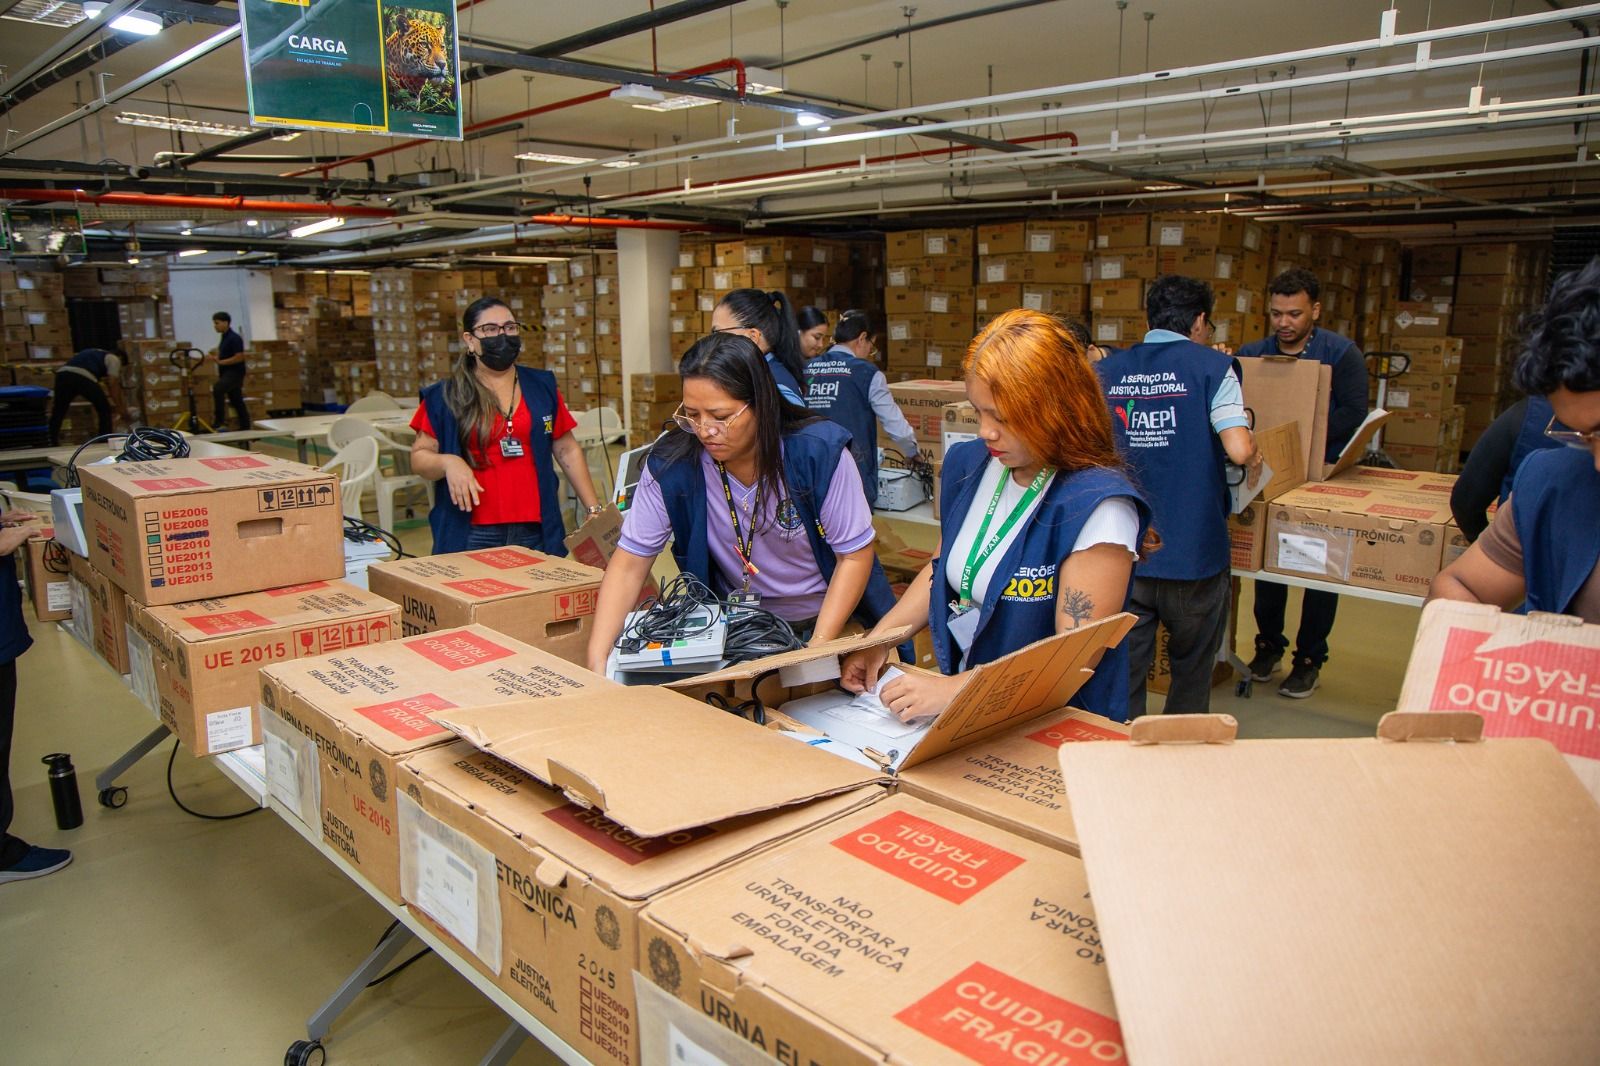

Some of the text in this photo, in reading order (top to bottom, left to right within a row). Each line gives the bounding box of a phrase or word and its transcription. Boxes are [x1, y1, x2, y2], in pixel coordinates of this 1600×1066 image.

[288, 34, 348, 55] CARGA
[1108, 383, 1187, 397] JUSTIÇA ELEITORAL
[1121, 372, 1176, 385] A SERVIÇO DA
[962, 417, 979, 425] URN
[280, 489, 294, 502] 12
[987, 492, 1000, 515] IFAM
[162, 507, 208, 520] UE2006
[163, 518, 209, 531] UE2008
[165, 539, 211, 552] UE2010
[982, 533, 1000, 557] IFAM
[1333, 527, 1406, 545] ELETRÔNICA
[166, 551, 211, 564] UE2011
[167, 562, 212, 575] UE2013
[1356, 566, 1383, 576] JUSTIÇA
[168, 573, 214, 586] UE2015
[961, 565, 972, 590] IFAM
[1352, 571, 1387, 583] ELEITORAL
[1395, 574, 1431, 586] UE2015
[402, 594, 438, 627] URNA
[576, 593, 589, 605] 12
[322, 628, 341, 642] 12
[204, 642, 286, 670] UE 2015
[423, 639, 476, 667] CUIDADO
[307, 669, 351, 695] EMBALAGEM
[326, 670, 349, 683] FORA
[328, 657, 389, 695] URNA ELETRÔNICA
[345, 657, 393, 688] TRANSPORTAR
[1448, 683, 1600, 731] UIDADO
[304, 724, 363, 779] ELETRÔNICA
[965, 756, 1005, 774] URNA
[454, 760, 518, 797] EMBALAGEM
[480, 759, 523, 787] FORA DA
[988, 774, 1055, 800] FORA DA
[963, 773, 1062, 810] EMBALAGEM
[326, 810, 355, 843] JUSTIÇA
[352, 794, 392, 836] UE 2015
[322, 823, 361, 865] ELEITORAL
[896, 824, 989, 870] FRÁGIL
[857, 832, 978, 889] CUIDADO
[496, 858, 578, 929] ETRÔNICA
[770, 877, 911, 958] TRANSPORTAR A
[832, 896, 874, 920] NÃO
[745, 881, 905, 973] URNA ELETRÔNICA
[764, 912, 842, 960] FORA DA
[731, 912, 845, 978] EMBALAGEM
[510, 967, 558, 1014] ELEITORAL
[594, 986, 630, 1020] UE2009
[594, 1002, 630, 1035] UE2010
[700, 990, 768, 1052] URNA
[956, 981, 1124, 1061] CUIDADO
[594, 1017, 629, 1049] UE2011
[594, 1032, 630, 1066] UE2013
